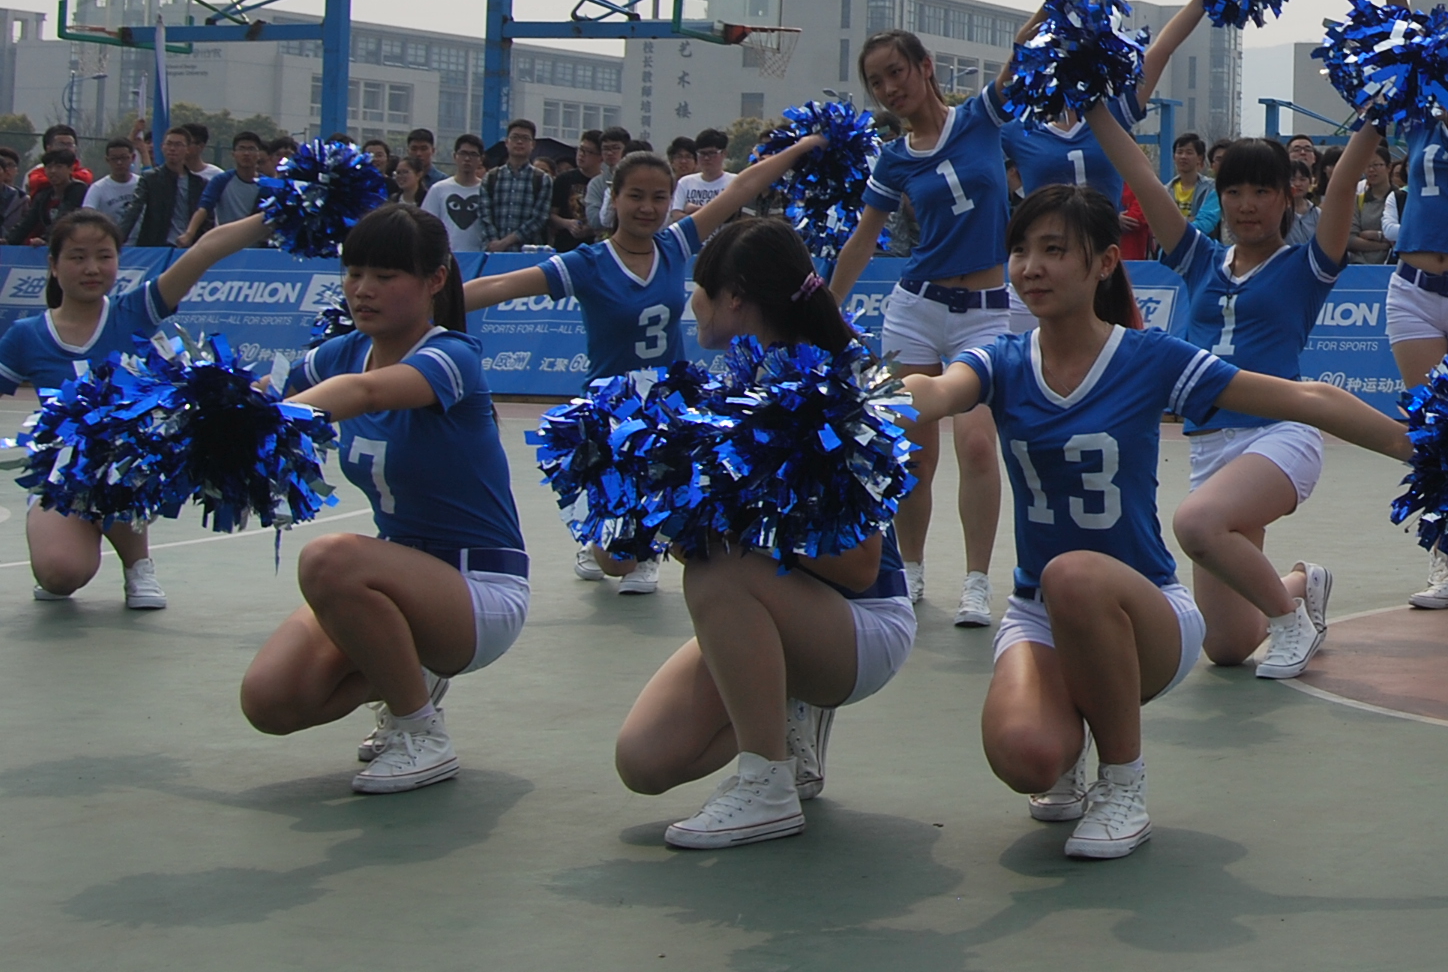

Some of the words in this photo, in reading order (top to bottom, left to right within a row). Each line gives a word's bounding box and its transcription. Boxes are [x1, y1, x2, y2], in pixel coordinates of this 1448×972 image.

[936, 159, 975, 216] 1
[1067, 149, 1087, 187] 1
[481, 323, 515, 334] SPORTS
[516, 324, 534, 334] FOR
[635, 303, 670, 359] 3
[1211, 294, 1238, 356] 1
[1316, 341, 1338, 351] FOR
[1339, 341, 1379, 351] SPORTS
[348, 435, 395, 514] 7
[1010, 432, 1122, 529] 13
